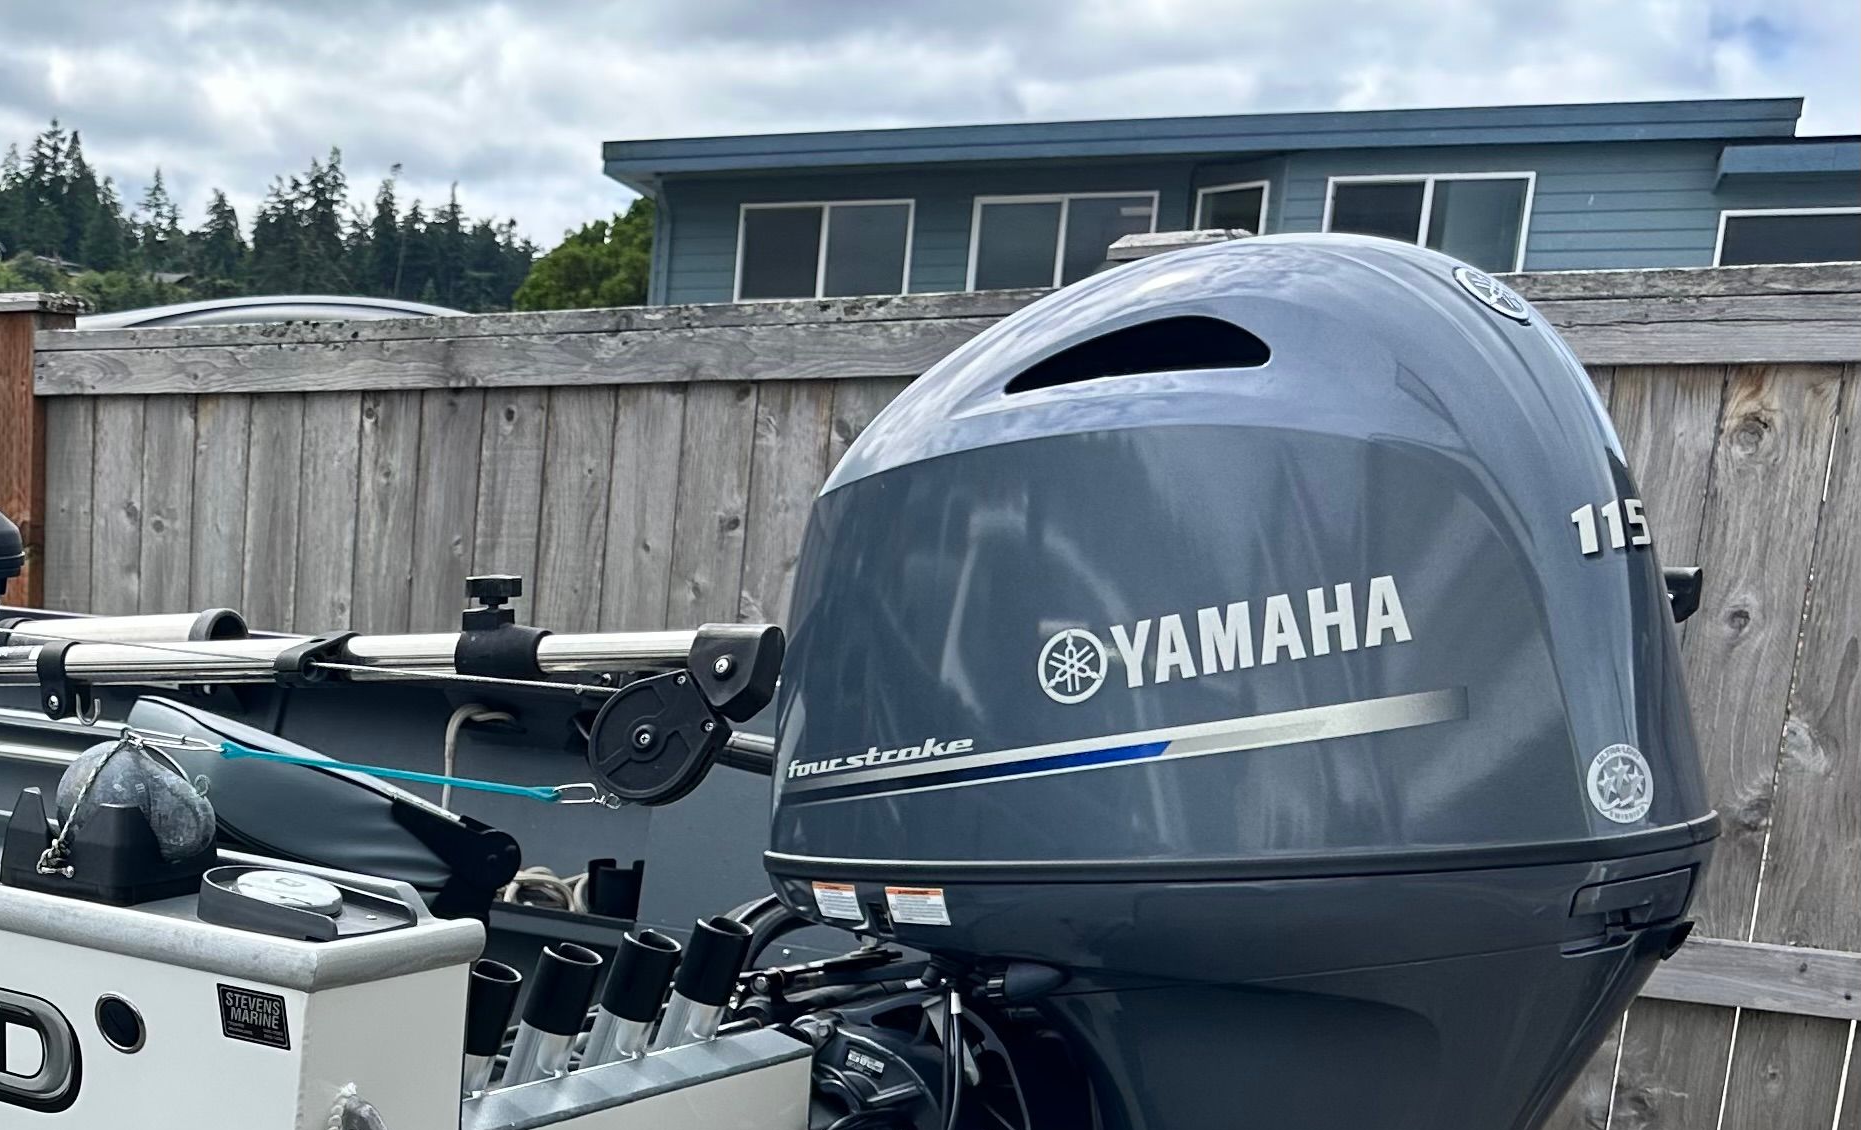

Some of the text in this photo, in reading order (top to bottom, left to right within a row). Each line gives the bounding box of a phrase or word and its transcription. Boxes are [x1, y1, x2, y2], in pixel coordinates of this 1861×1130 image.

[1570, 498, 1652, 555] 115
[1109, 574, 1413, 689] YAMAHA
[226, 992, 281, 1016] STEVENS
[230, 1006, 280, 1029] MARINE
